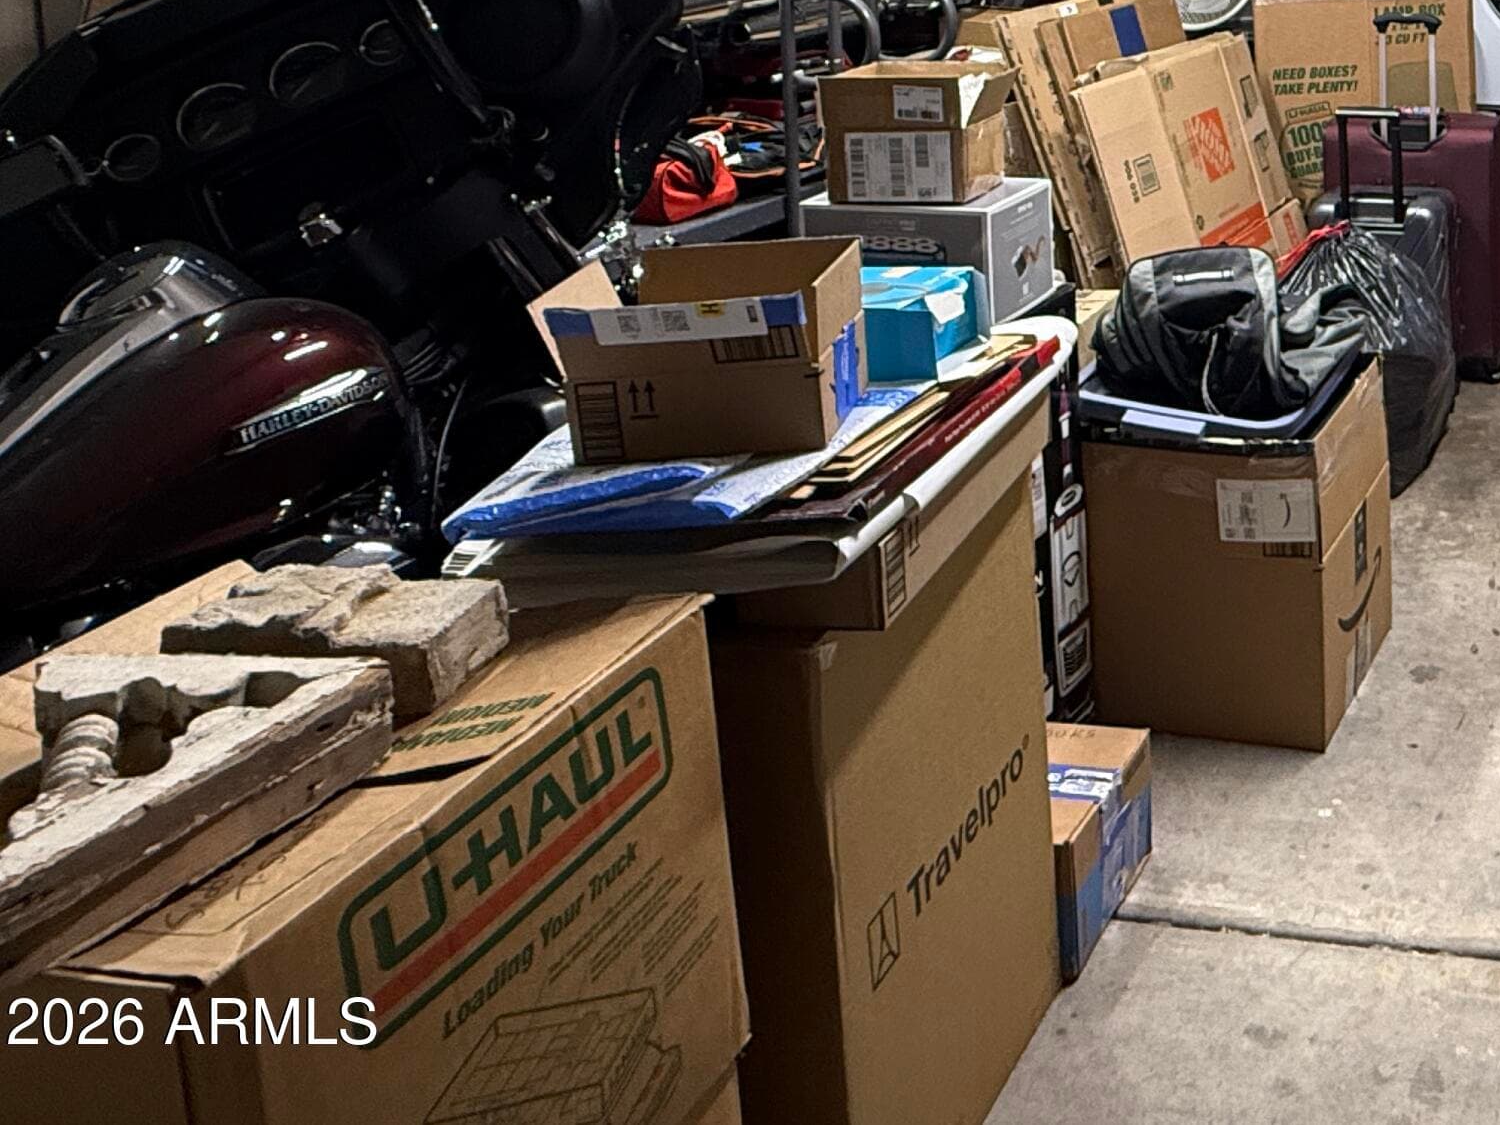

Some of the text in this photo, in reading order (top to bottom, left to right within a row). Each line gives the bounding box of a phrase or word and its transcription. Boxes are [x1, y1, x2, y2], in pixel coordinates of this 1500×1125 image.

[1272, 64, 1358, 81] NEED BOXES?
[1274, 80, 1358, 95] TAKE PLENTY!
[369, 709, 653, 972] U-HAUL
[906, 747, 1025, 917] Travelpro
[442, 941, 535, 1039] Loading
[539, 892, 585, 949] Your
[588, 840, 640, 903] Truck
